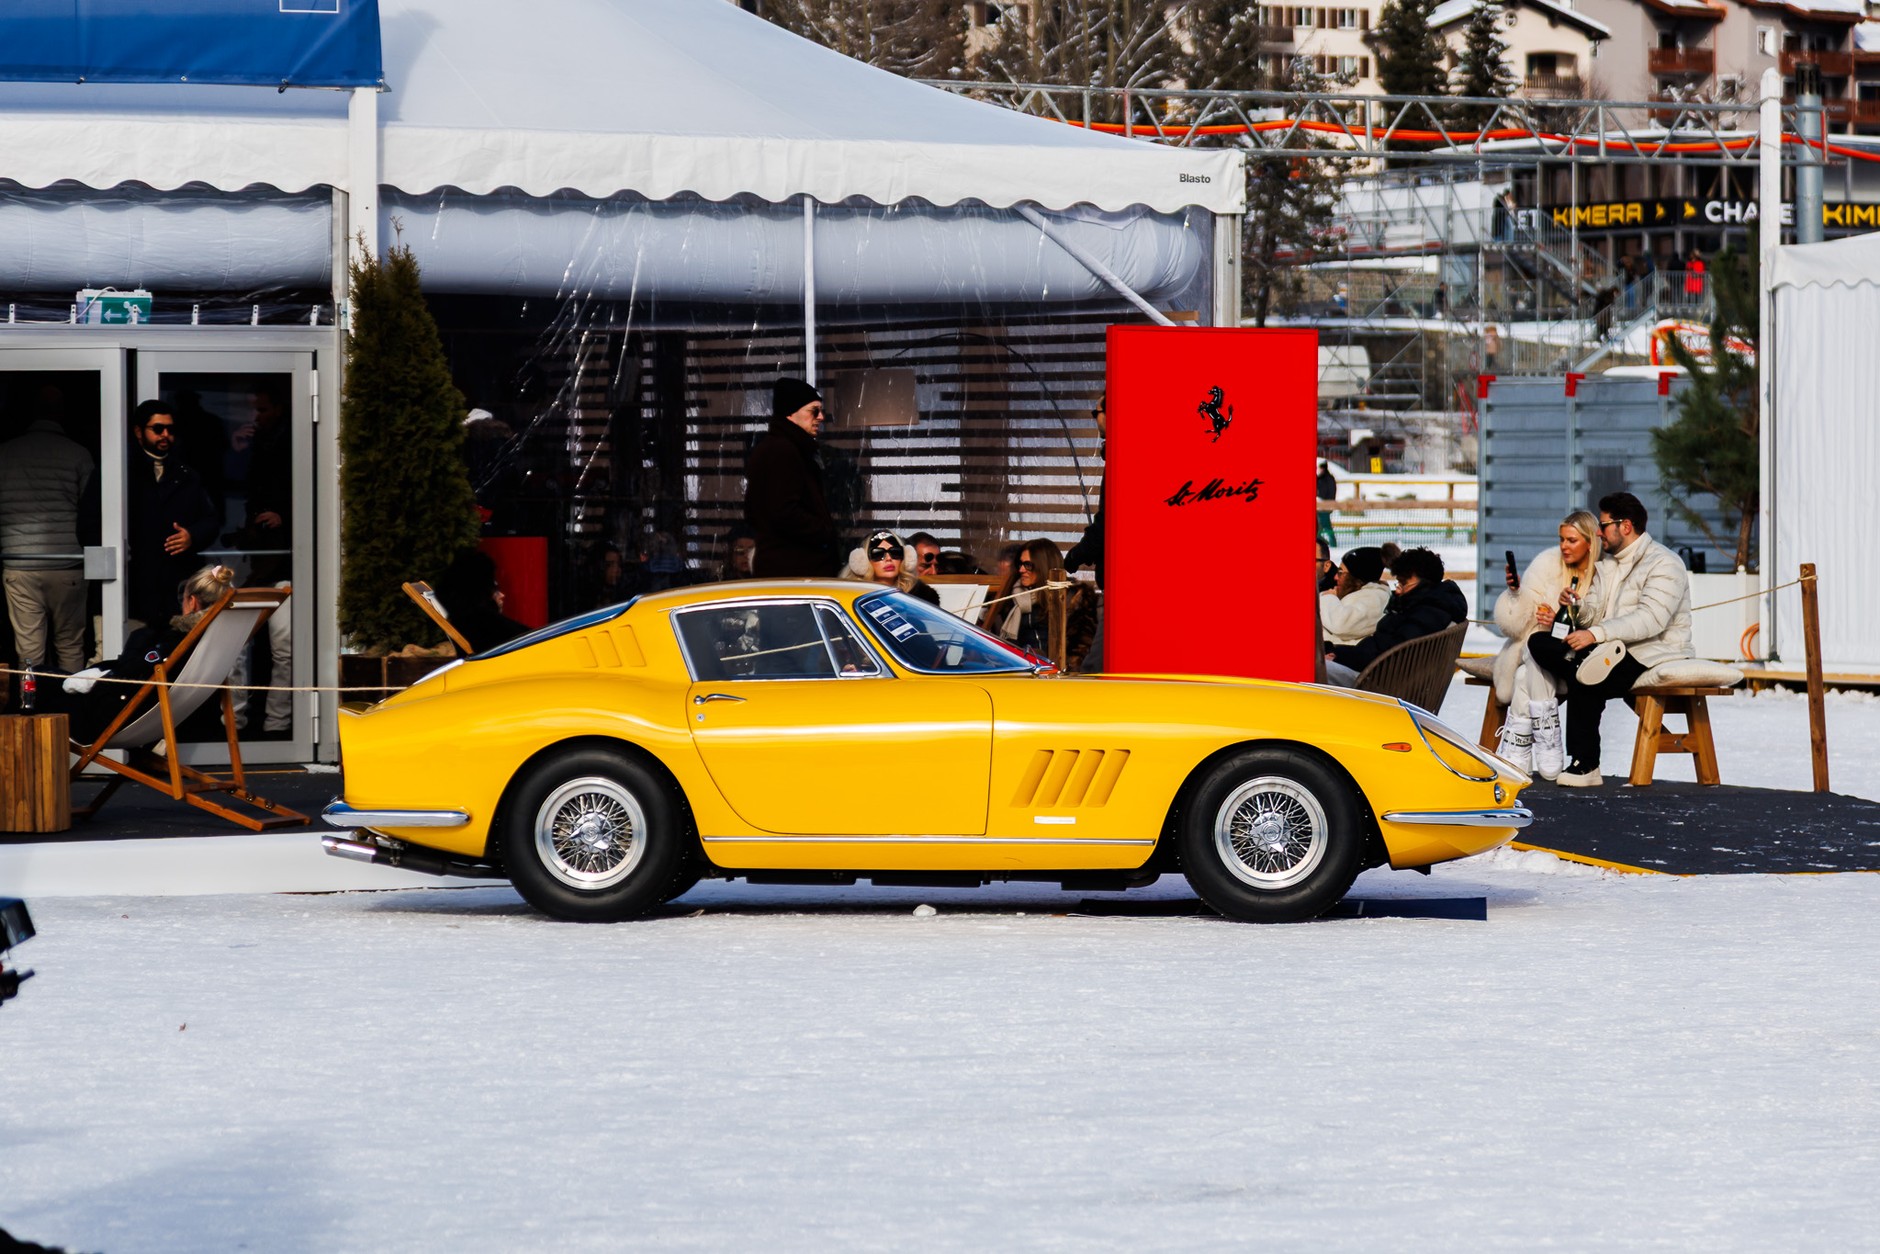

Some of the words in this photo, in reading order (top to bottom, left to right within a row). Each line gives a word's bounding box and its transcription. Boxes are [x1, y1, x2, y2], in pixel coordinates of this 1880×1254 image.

[1179, 173, 1211, 184] Blasto
[1553, 203, 1643, 228] KIMERA
[1822, 203, 1880, 227] KIM
[1187, 478, 1264, 503] Moritz
